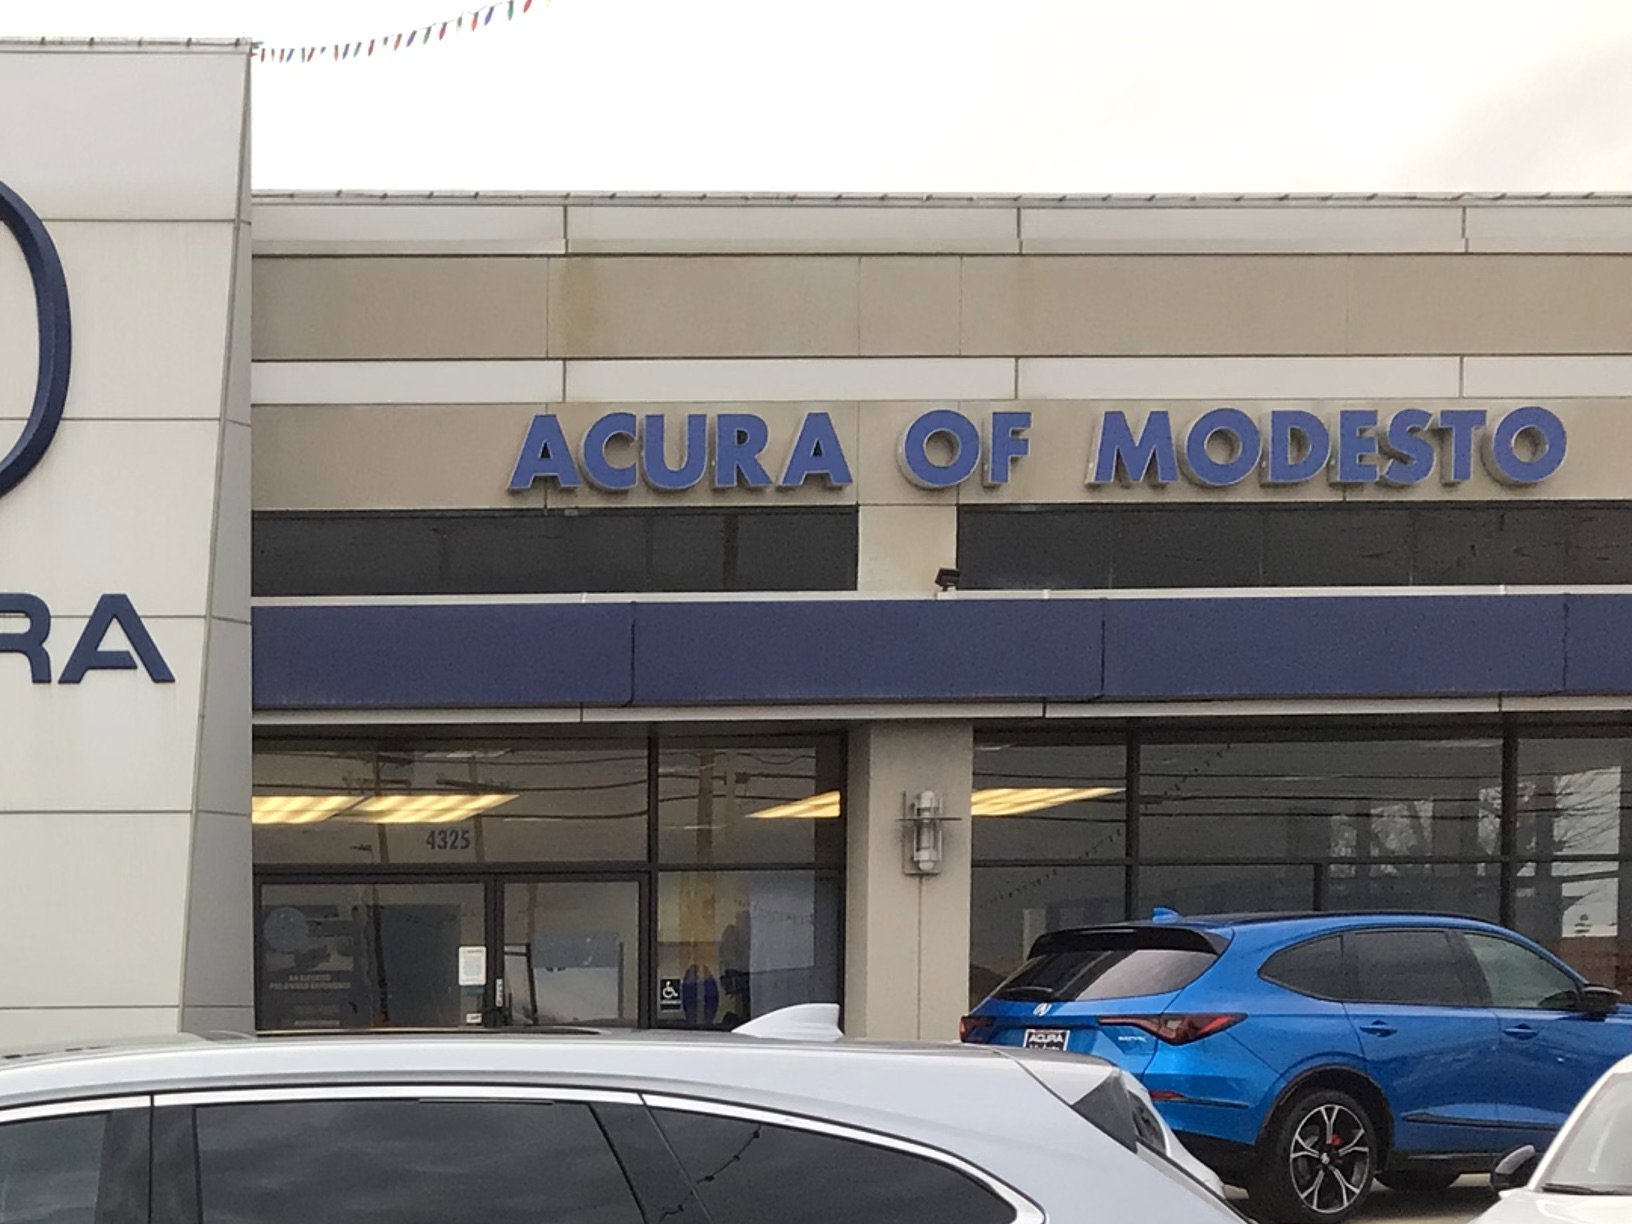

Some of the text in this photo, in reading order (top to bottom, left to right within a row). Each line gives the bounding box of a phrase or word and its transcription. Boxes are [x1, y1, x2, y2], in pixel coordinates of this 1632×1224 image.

[508, 406, 1568, 491] ACURA OF MODESTO
[426, 829, 470, 850] 4325
[1028, 1034, 1064, 1044] ACURA
